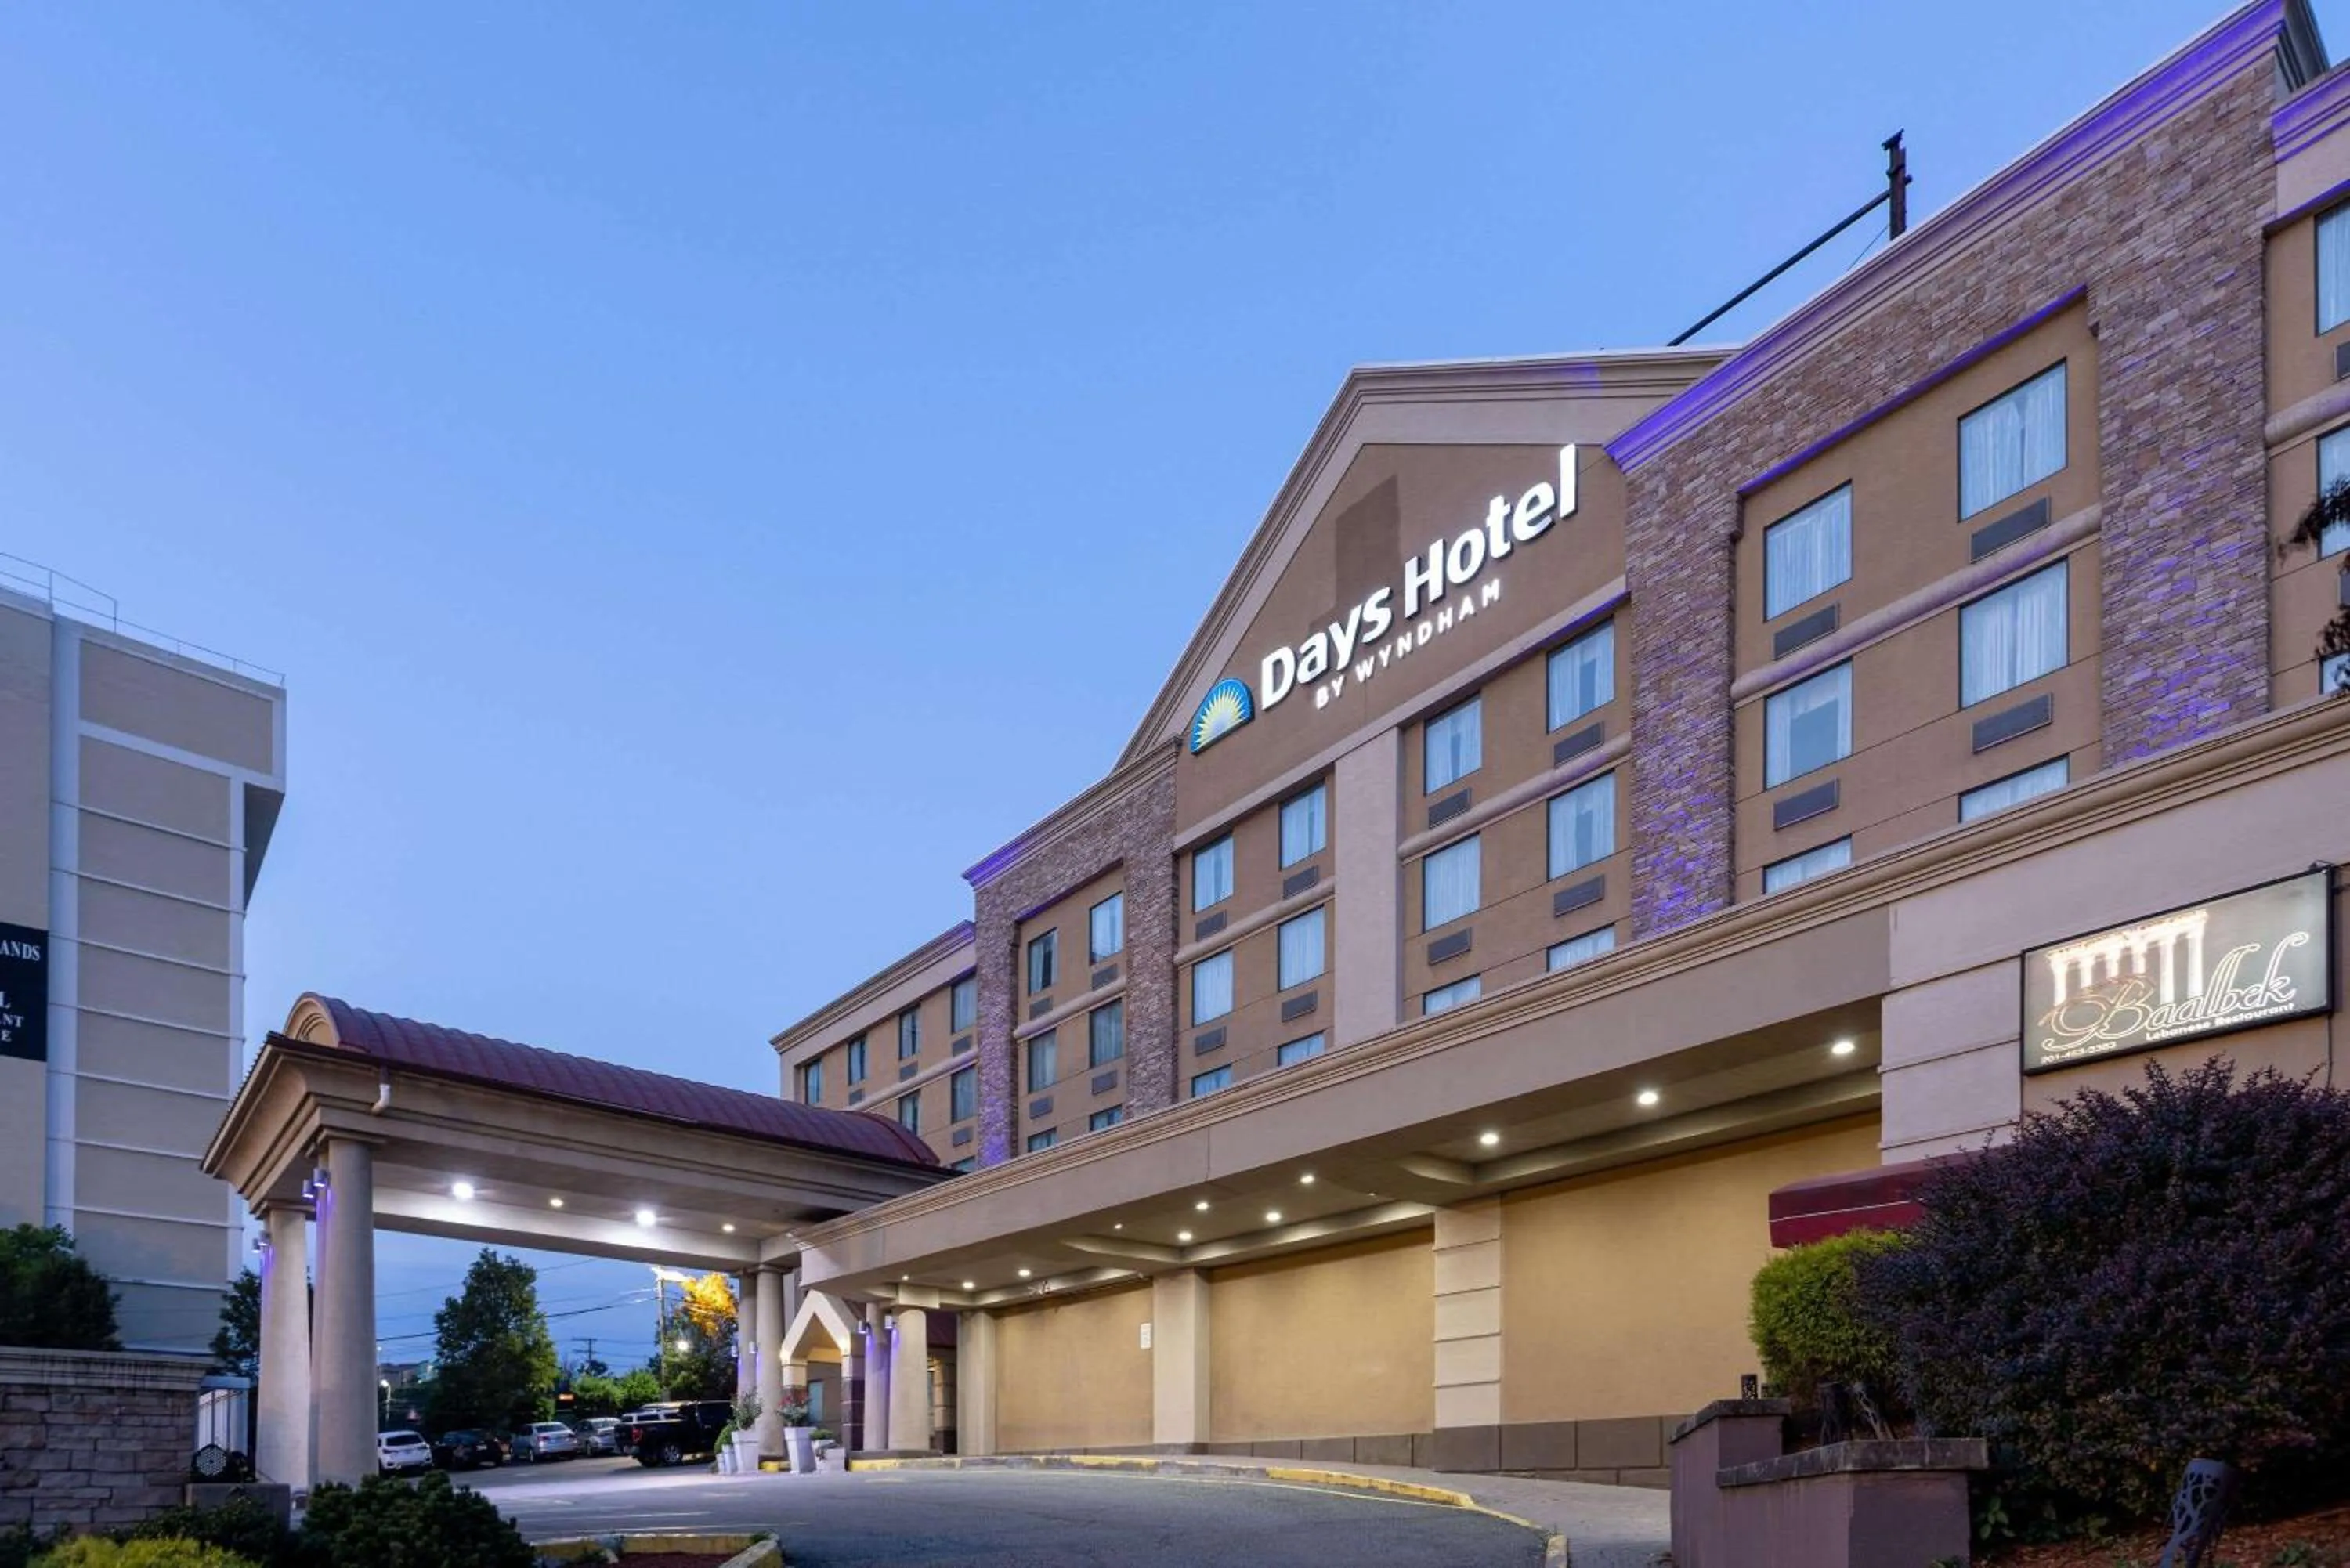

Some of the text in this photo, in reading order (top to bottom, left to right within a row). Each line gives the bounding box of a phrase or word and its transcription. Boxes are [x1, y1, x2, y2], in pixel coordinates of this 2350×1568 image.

[1260, 443, 1578, 711] Days Hotel
[1315, 578, 1502, 710] BY WYNDHAM
[2038, 931, 2309, 1051] Baalbek
[2145, 1003, 2294, 1042] Lebanese Restaurant
